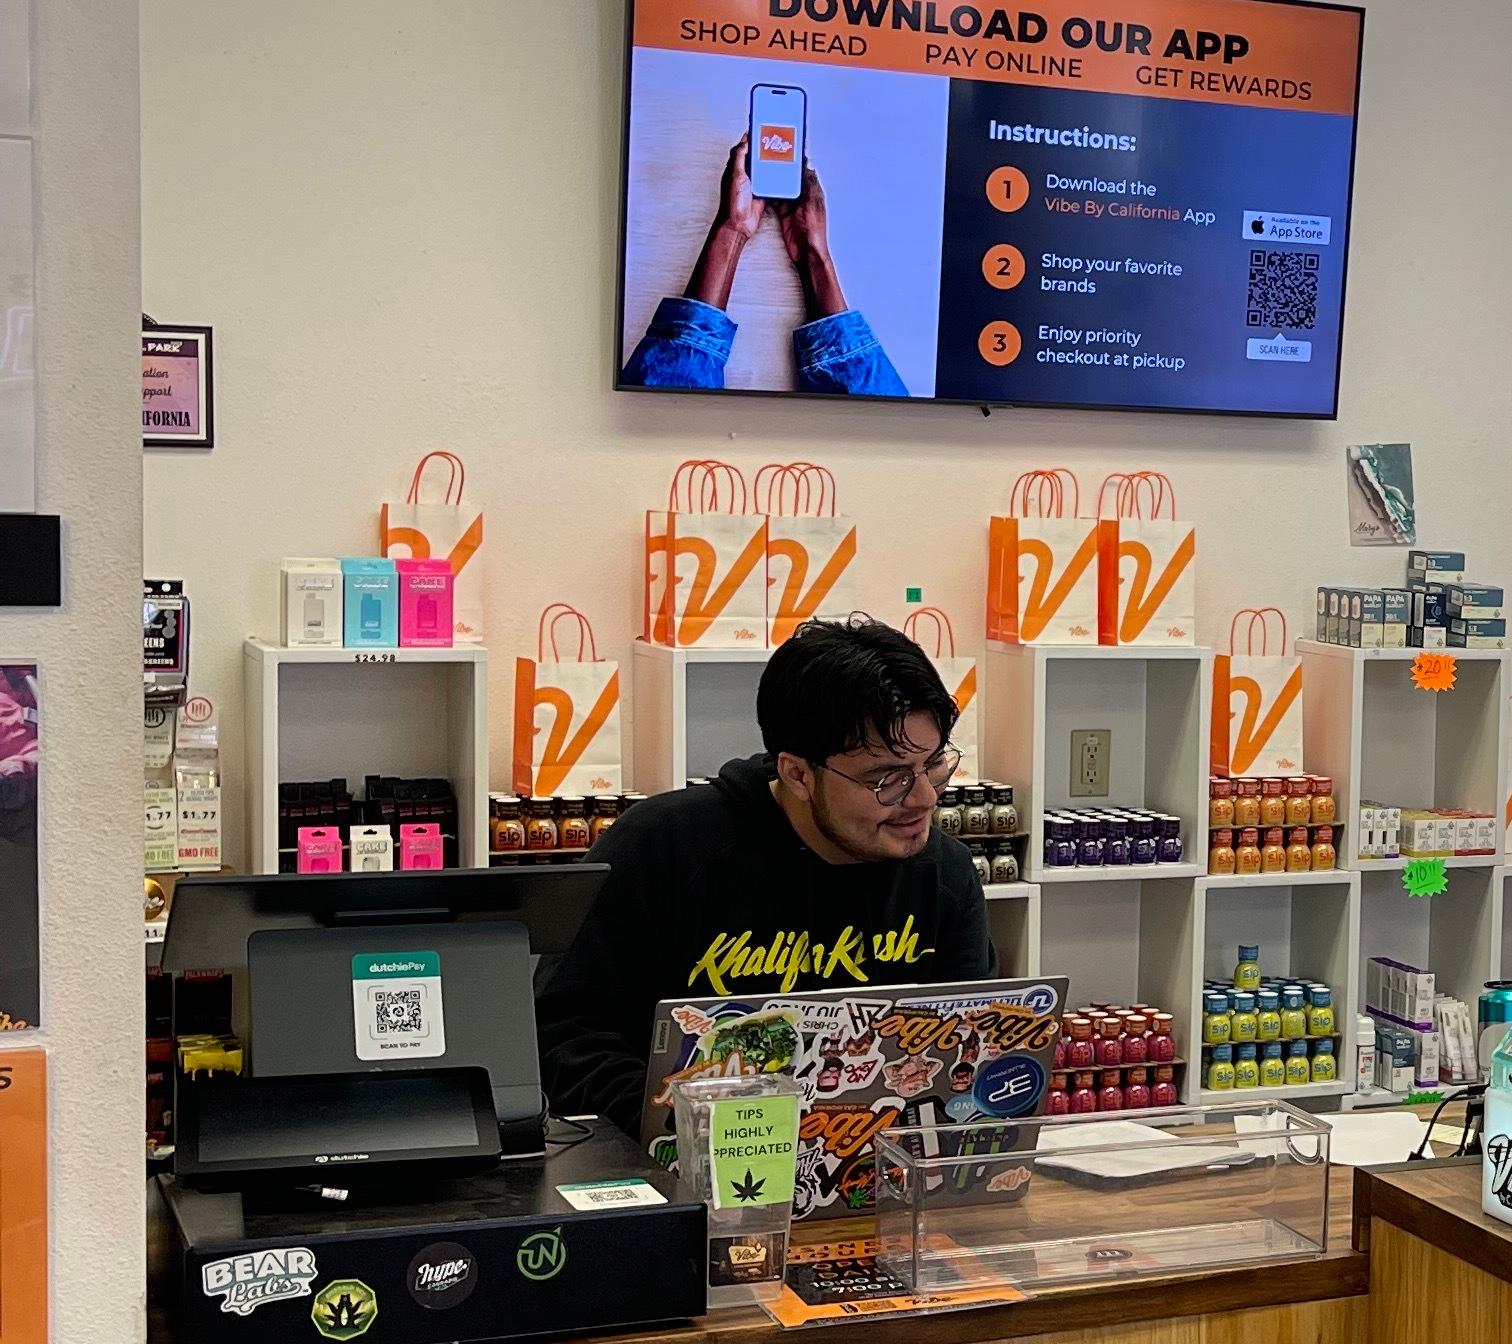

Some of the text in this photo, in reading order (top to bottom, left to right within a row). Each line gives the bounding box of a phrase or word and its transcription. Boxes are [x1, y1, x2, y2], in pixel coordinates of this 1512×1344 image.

[680, 19, 867, 56] SHOP AHEAD
[1061, 17, 1152, 56] OUR
[1163, 29, 1249, 64] APP
[925, 44, 1083, 78] PAY ONLINE
[1136, 65, 1312, 100] GET REWARDS
[990, 119, 1137, 151] Instructions:
[1003, 180, 1011, 199] 1
[1046, 174, 1156, 196] Download the
[1044, 197, 1215, 226] Vibe By California App
[1270, 225, 1322, 240] App Store
[996, 257, 1011, 276] 2
[1041, 254, 1182, 276] Shop your favorite
[1040, 276, 1096, 293] brands
[992, 333, 1007, 352] 3
[1038, 325, 1141, 348] Enjoy priority
[1036, 348, 1185, 371] checkout at pickup
[970, 814, 989, 830] sip
[996, 813, 1016, 828] sip
[499, 830, 521, 842] sip
[530, 828, 552, 843] sip
[566, 828, 587, 842] sip
[178, 846, 218, 858] GMO FREE
[996, 864, 1015, 879] sip
[802, 1021, 839, 1031] CHRIS
[871, 1013, 961, 1055] Vibe
[967, 1010, 1053, 1052] Vibe
[736, 1109, 763, 1121] TIPS
[724, 1126, 774, 1140] HIGHLY
[800, 1105, 902, 1158] Vibe
[206, 1250, 313, 1290] BEAR
